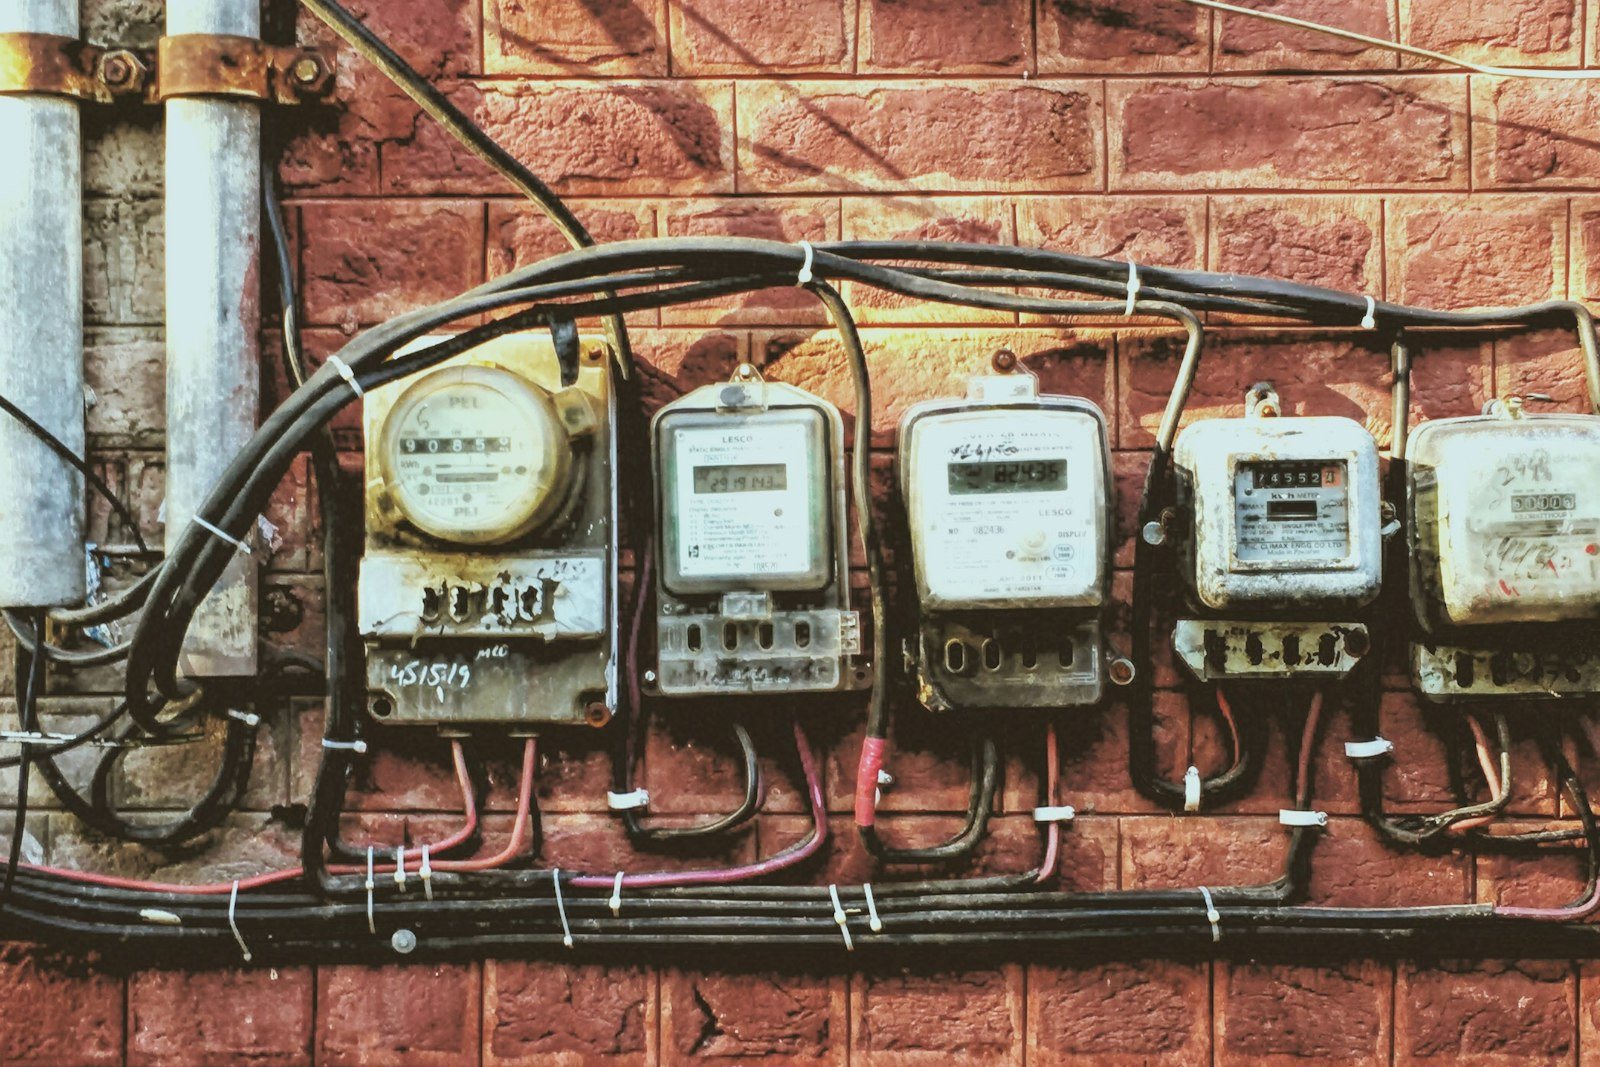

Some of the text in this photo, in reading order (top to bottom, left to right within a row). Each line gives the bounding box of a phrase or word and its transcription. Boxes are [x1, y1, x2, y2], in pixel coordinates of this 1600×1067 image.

[722, 435, 753, 444] LESCO
[1038, 508, 1073, 517] LESCO
[1260, 542, 1289, 550] CLIMAX
